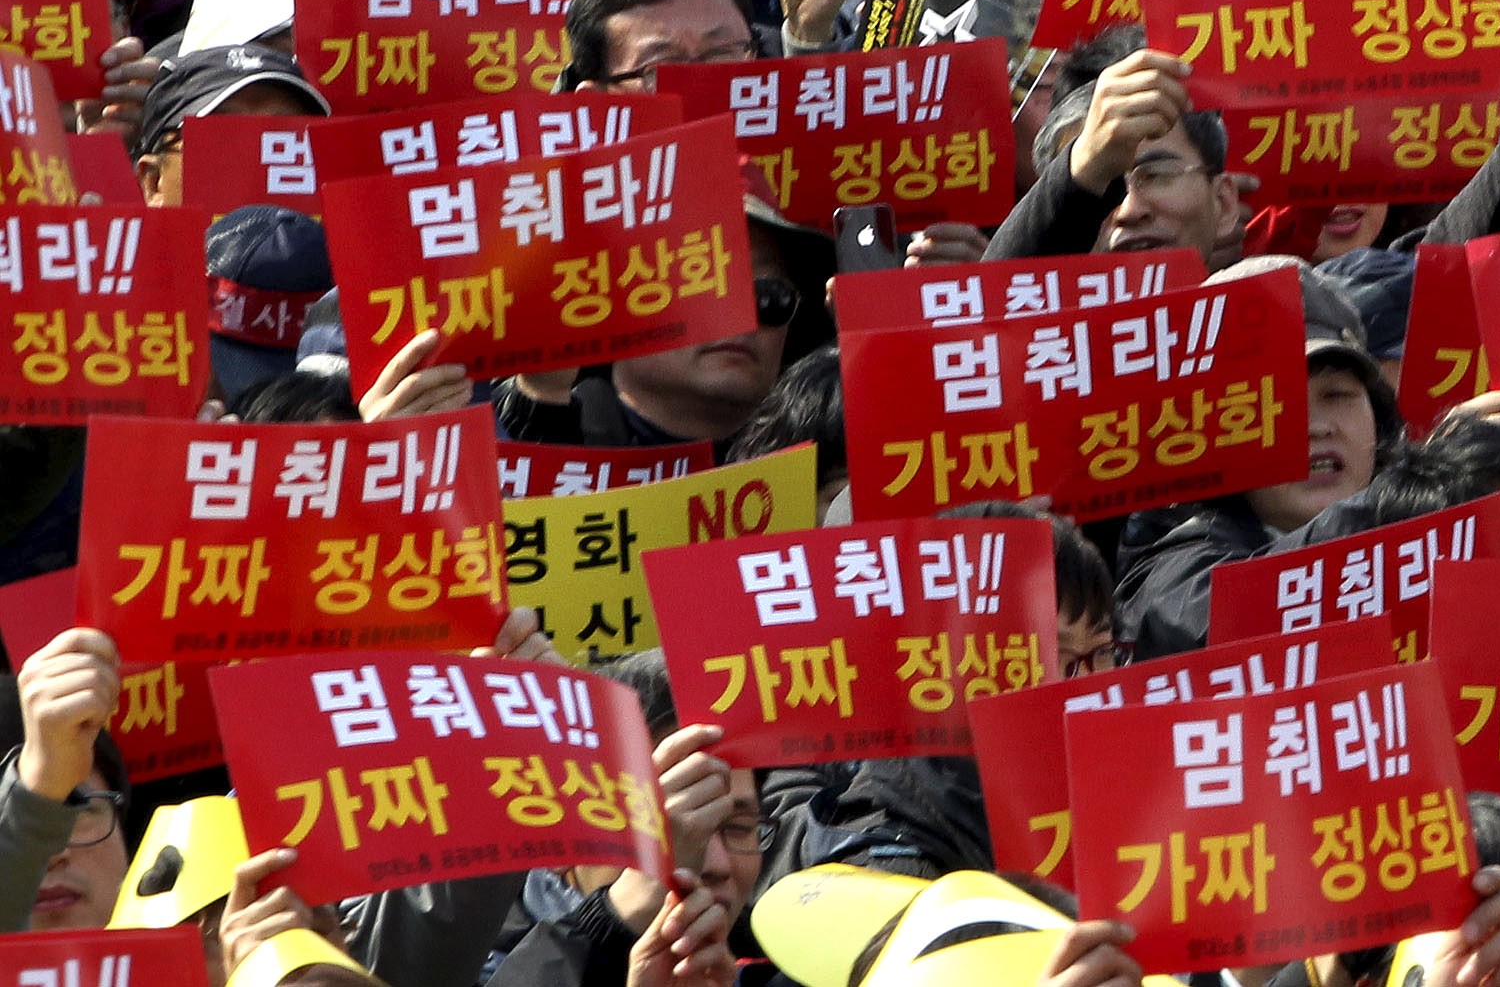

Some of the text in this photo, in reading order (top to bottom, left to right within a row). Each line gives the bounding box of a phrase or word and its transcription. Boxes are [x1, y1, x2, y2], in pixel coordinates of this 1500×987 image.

[321, 32, 434, 92] 가짜
[1176, 1, 1314, 72] 가짜
[831, 129, 995, 202] 정상화
[370, 226, 730, 343] 가짜 정상화
[15, 311, 192, 384] 정상화
[884, 376, 1283, 502] 가짜 정상화
[687, 478, 775, 544] NO
[113, 518, 507, 617] 가짜 정상화
[704, 633, 1044, 721] 가짜 정상화
[277, 758, 448, 849] 가짜
[1118, 789, 1468, 922] 가짜 정상화
